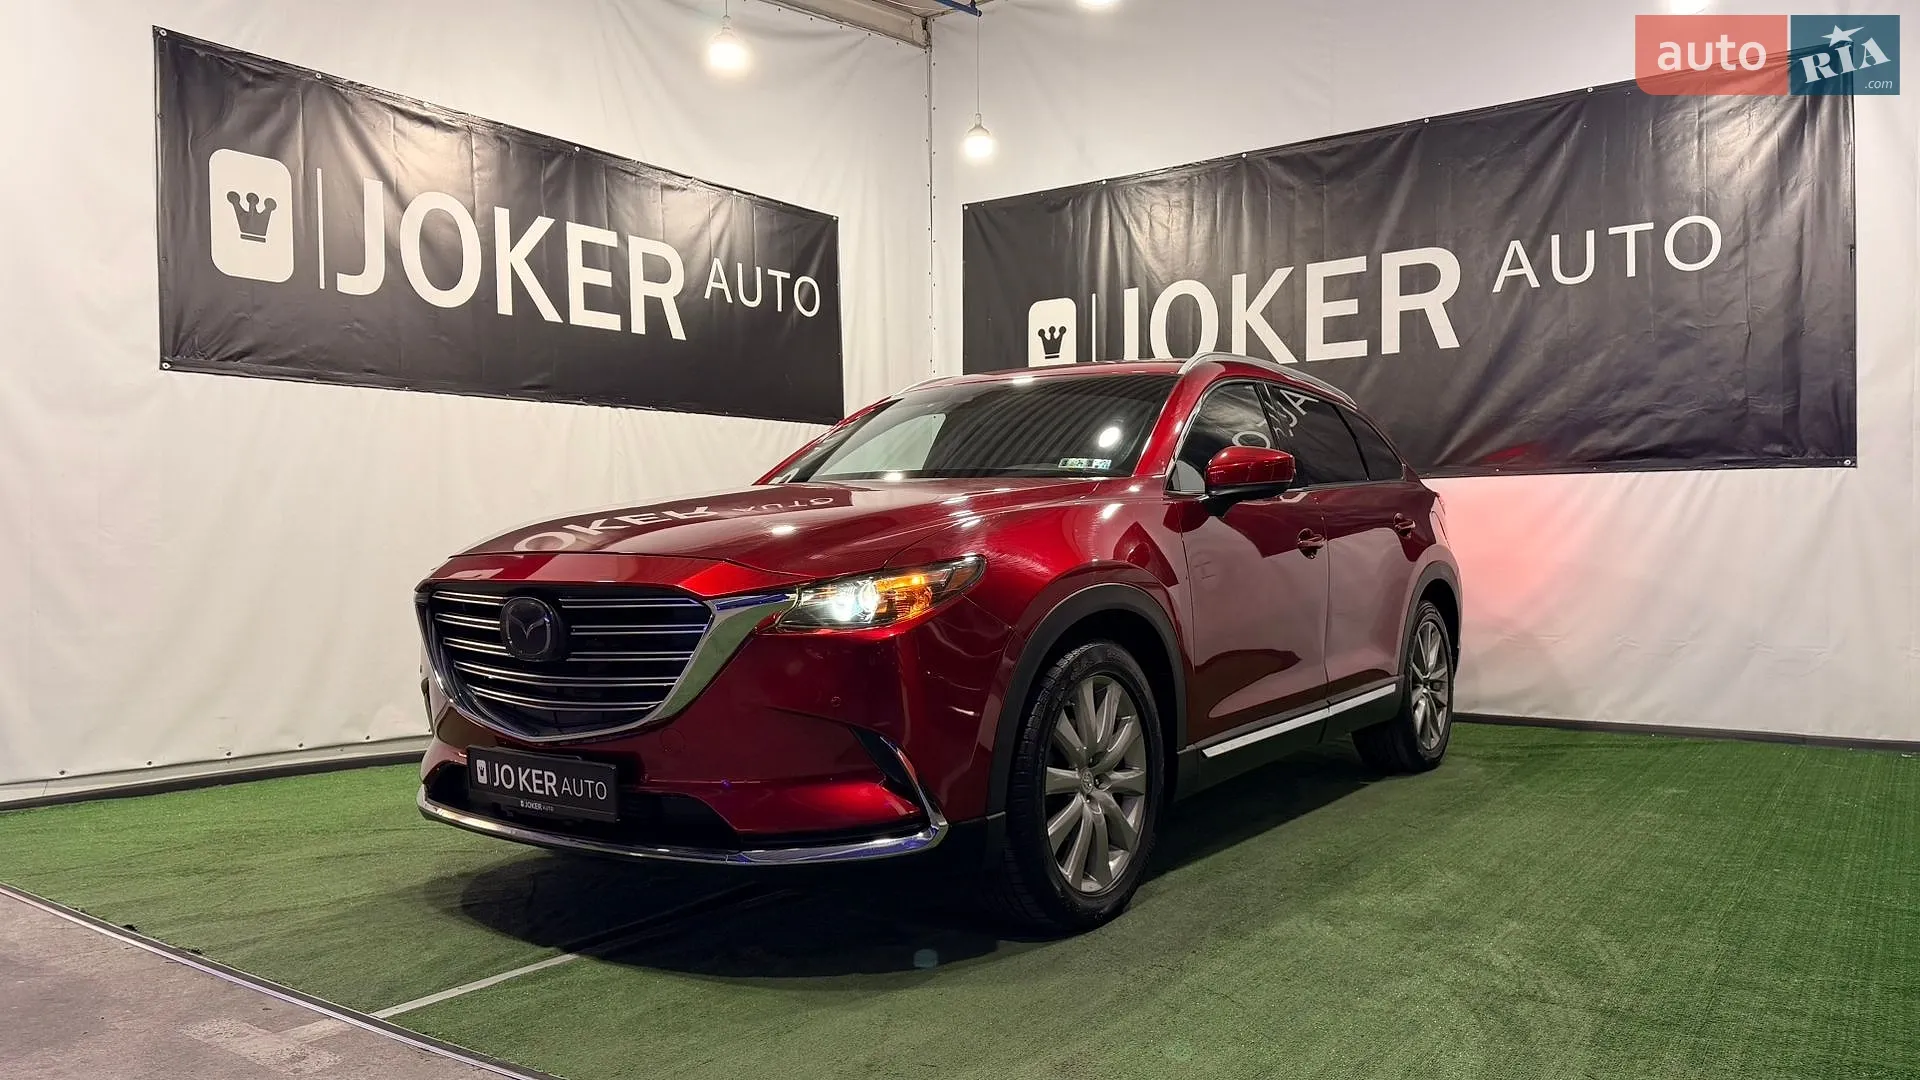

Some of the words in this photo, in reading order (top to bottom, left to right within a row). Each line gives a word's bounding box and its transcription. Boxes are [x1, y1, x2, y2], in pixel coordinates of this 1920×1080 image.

[336, 177, 687, 341] JOKER
[703, 256, 822, 318] AUTO
[1493, 215, 1723, 293] AUTO
[493, 762, 559, 797] JOKER
[561, 777, 607, 801] AUTO
